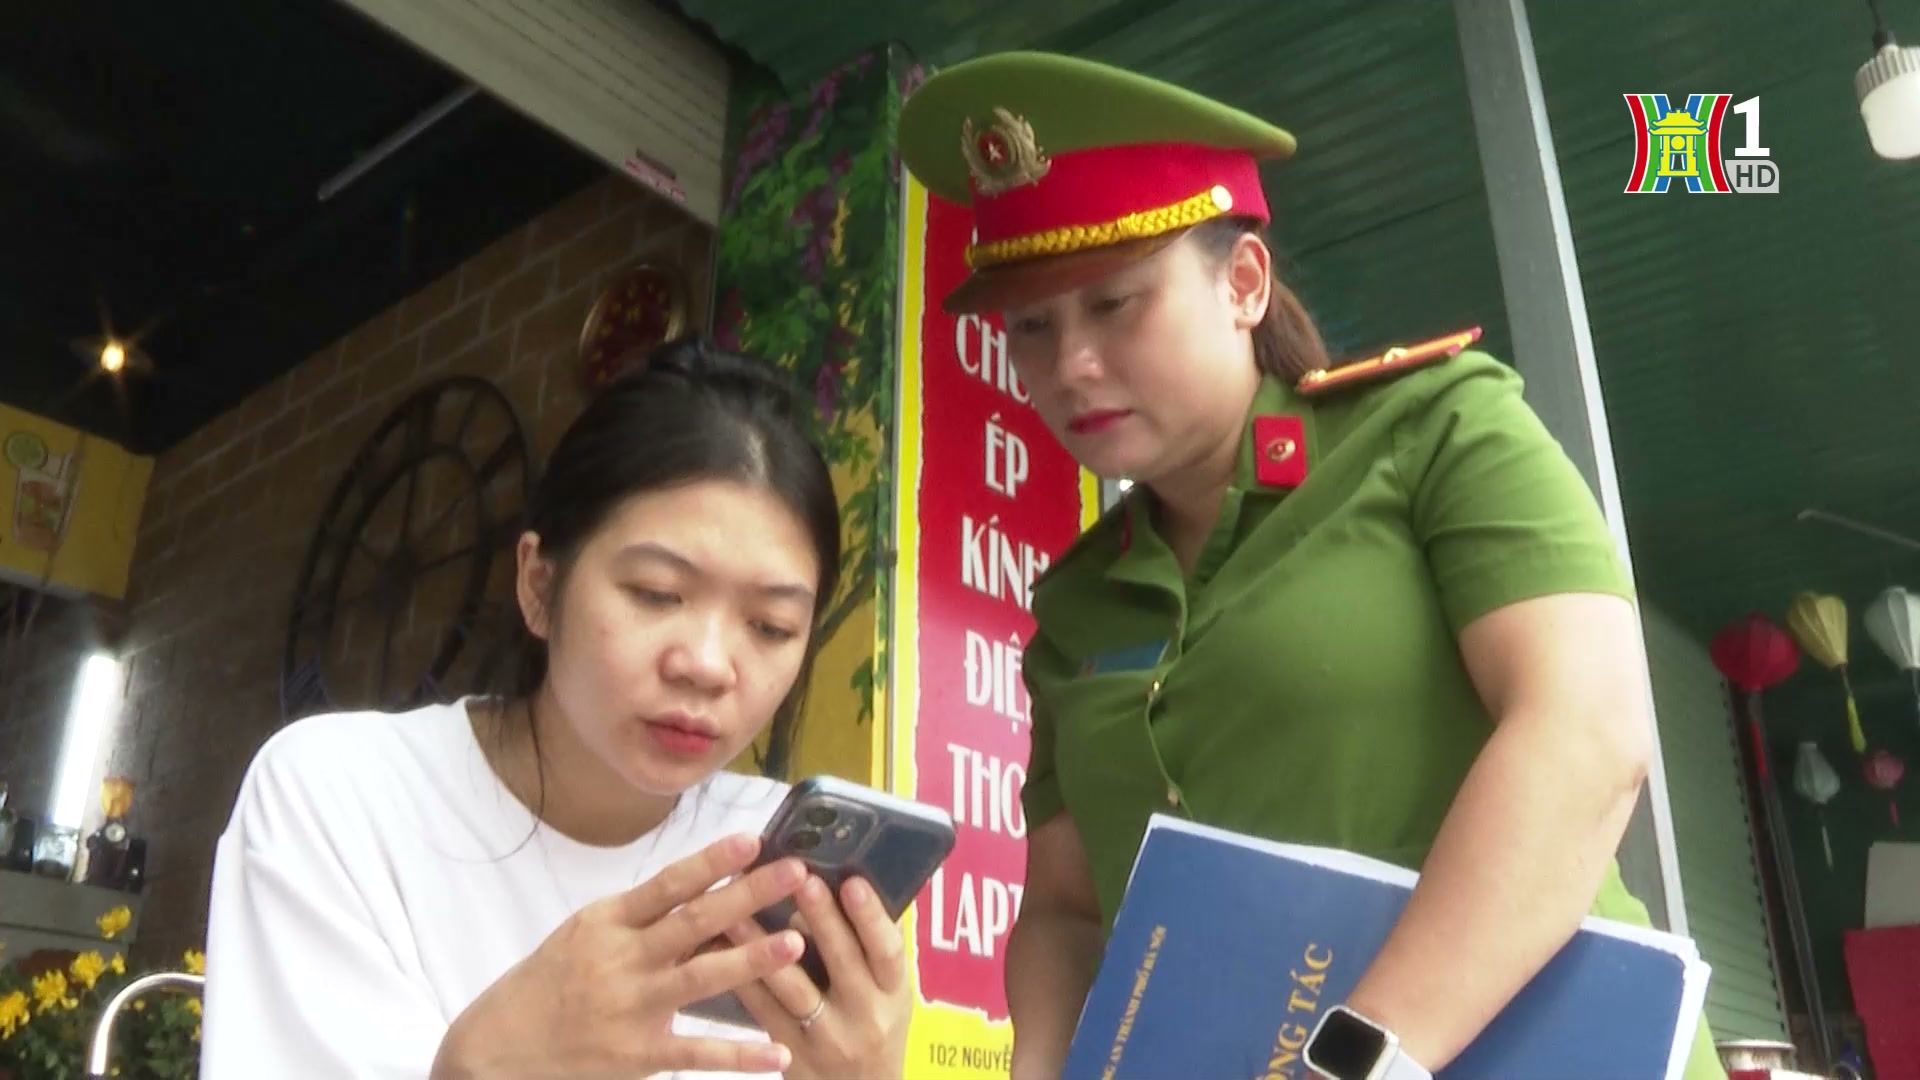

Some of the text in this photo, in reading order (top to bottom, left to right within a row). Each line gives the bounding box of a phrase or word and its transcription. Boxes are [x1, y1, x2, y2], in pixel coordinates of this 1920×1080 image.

[985, 411, 1029, 498] ÉP
[961, 513, 1050, 614] KÍNH
[963, 630, 1032, 734] ĐIỆ
[947, 742, 1027, 839] THO
[1288, 943, 1333, 1013] TÁC
[929, 1043, 957, 1067] 102
